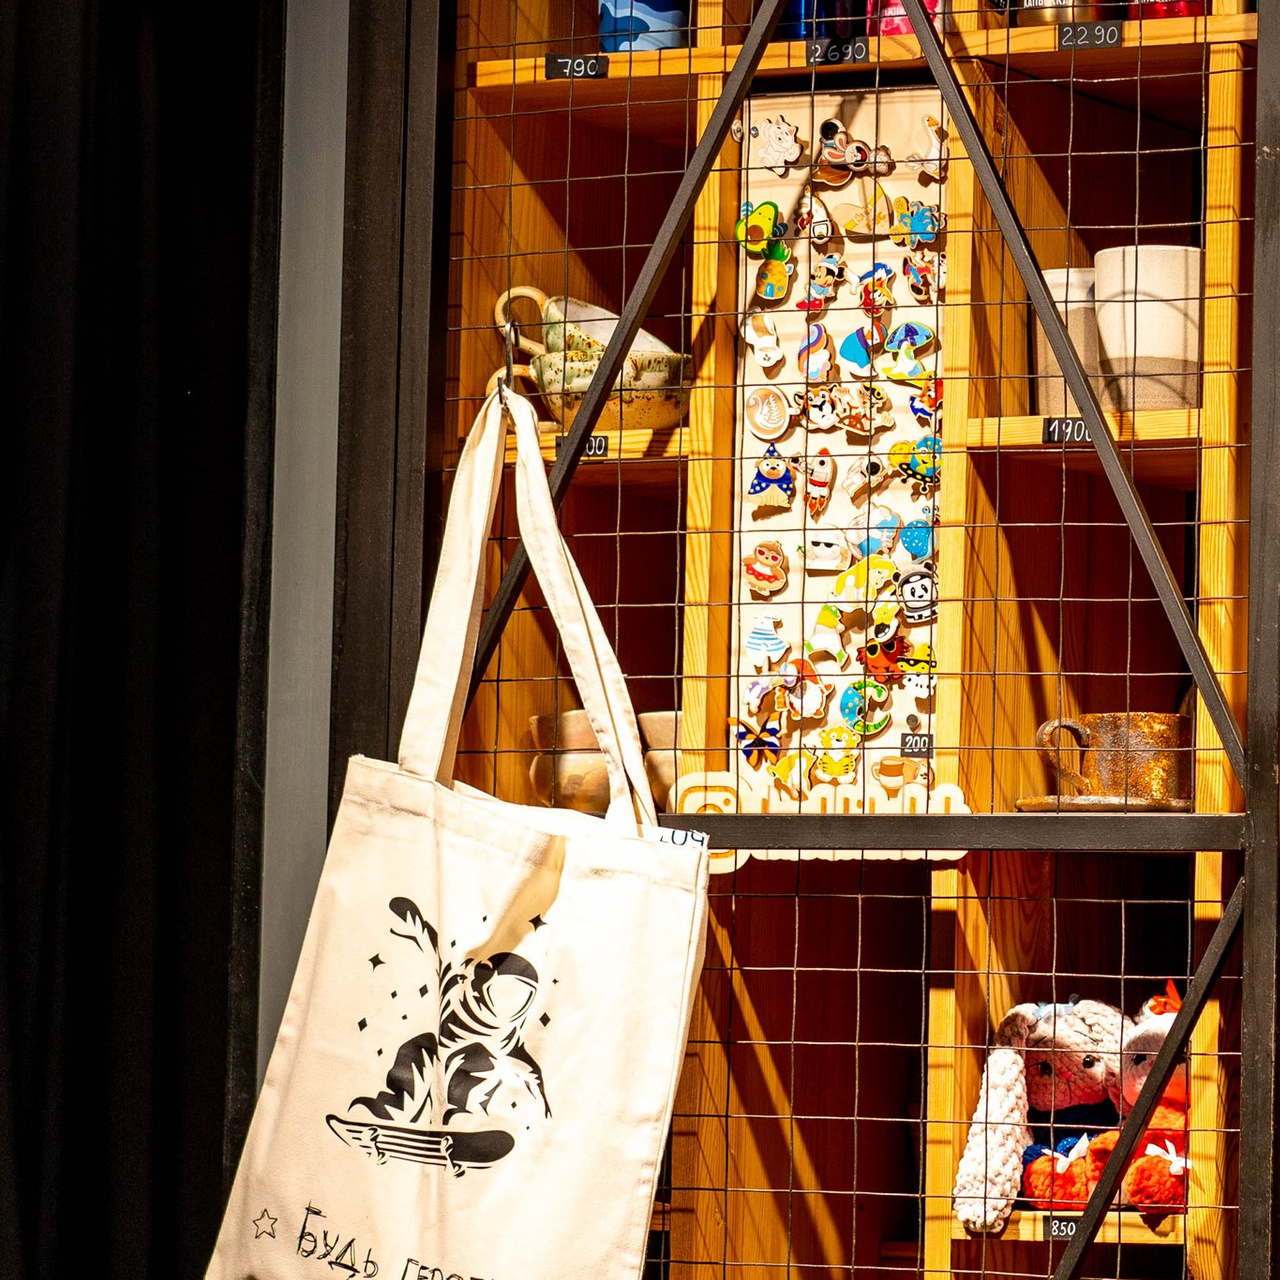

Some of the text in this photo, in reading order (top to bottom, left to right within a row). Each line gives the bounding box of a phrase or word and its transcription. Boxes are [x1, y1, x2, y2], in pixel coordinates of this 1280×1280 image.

[1061, 25, 1118, 46] 2290
[809, 42, 866, 63] 2690
[557, 58, 599, 77] 790
[904, 735, 929, 753] 200
[1051, 1219, 1076, 1236] 850
